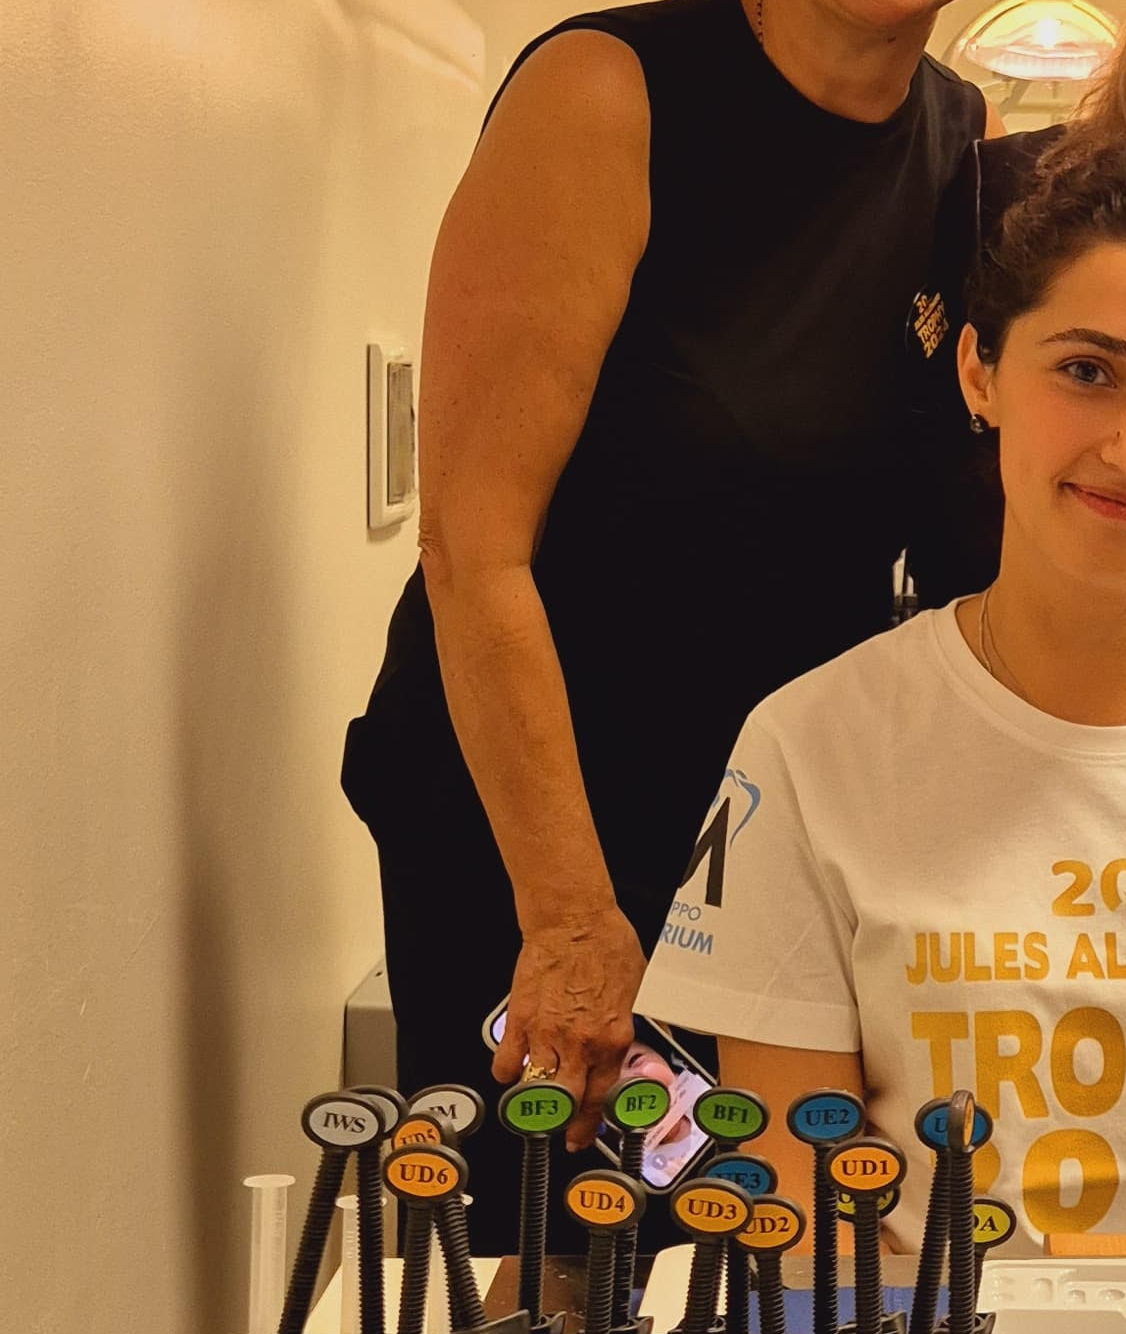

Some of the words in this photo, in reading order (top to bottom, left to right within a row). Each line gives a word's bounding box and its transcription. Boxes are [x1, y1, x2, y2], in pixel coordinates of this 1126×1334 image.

[671, 901, 701, 921] PPO
[659, 923, 714, 955] RIUM
[905, 930, 1050, 984] JULES
[520, 1099, 559, 1117] BF3
[625, 1095, 657, 1113] BF2
[713, 1104, 749, 1124] BF1
[322, 1112, 367, 1134] IWS
[805, 1108, 850, 1127] UE2
[399, 1163, 449, 1185] UD6
[840, 1159, 890, 1177] UD1
[579, 1190, 627, 1213] UD4
[688, 1198, 738, 1220] UD3
